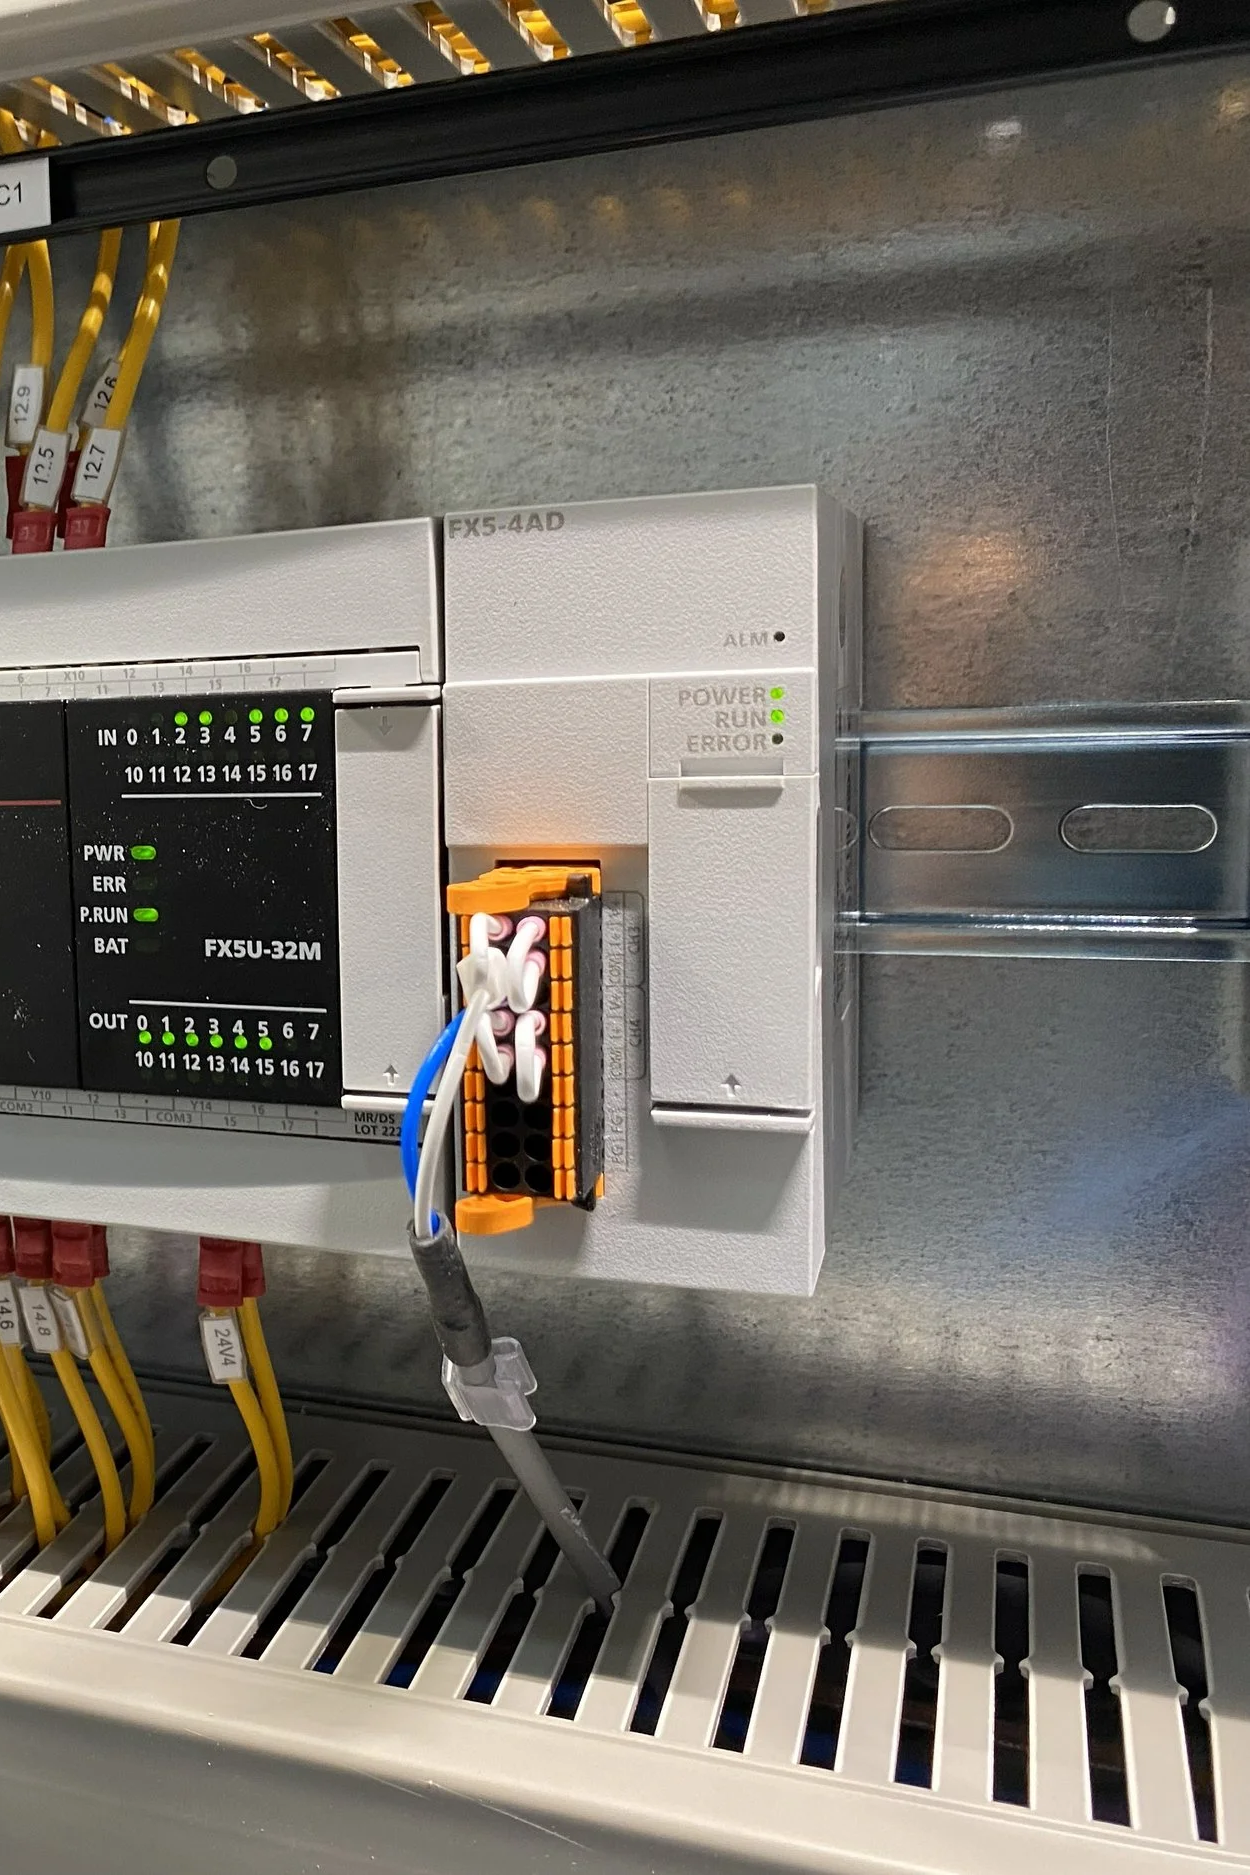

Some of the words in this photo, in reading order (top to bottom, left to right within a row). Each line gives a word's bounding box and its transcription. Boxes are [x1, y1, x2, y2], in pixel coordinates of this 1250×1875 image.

[13, 386, 31, 424] 12.9
[83, 444, 105, 482] 12.7
[448, 511, 565, 538] FX5-4AD
[724, 632, 769, 648] ALM
[17, 673, 24, 683] 6
[63, 671, 85, 681] X10
[123, 668, 136, 679] 12
[180, 665, 193, 676] 14
[238, 663, 251, 673] 16
[45, 686, 50, 697] 7
[96, 684, 108, 695] 11
[151, 681, 165, 693] 13
[209, 679, 222, 690] 15
[268, 676, 281, 688] 17
[678, 686, 766, 706] POWER
[716, 709, 767, 729] RUN
[98, 729, 117, 746] IN
[126, 728, 137, 745] 0
[151, 728, 160, 745] 1
[175, 727, 186, 744] 2
[199, 727, 210, 744] 3
[224, 727, 236, 744] 4
[250, 726, 261, 743] 5
[275, 725, 286, 742] 6
[301, 725, 312, 742] 7
[686, 733, 768, 753] ERROR
[125, 767, 143, 784] 10
[149, 767, 166, 783] 11
[173, 766, 191, 783] 12
[198, 766, 216, 782] 13
[222, 765, 241, 782] 14
[247, 765, 266, 782] 15
[273, 764, 292, 781] 16
[299, 764, 317, 781] 17
[83, 845, 125, 862] PWR
[92, 876, 126, 892] ERR
[79, 906, 128, 924] P.RUN
[94, 937, 128, 954] BAT
[204, 938, 322, 961] FX5U-32M
[89, 1013, 128, 1030] OUT
[136, 1015, 148, 1031] 0
[162, 1016, 170, 1032] 1
[184, 1017, 195, 1033] 2
[208, 1018, 219, 1034] 3
[232, 1019, 244, 1036] 4
[258, 1021, 268, 1038] 5
[282, 1022, 294, 1039] 6
[308, 1023, 320, 1040] 7
[135, 1051, 153, 1068] 10
[159, 1052, 176, 1069] 11
[182, 1053, 201, 1070] 12
[206, 1055, 225, 1072] 13
[230, 1056, 249, 1074] 14
[255, 1057, 274, 1076] 15
[280, 1059, 299, 1077] 16
[305, 1061, 324, 1078] 17
[31, 1089, 51, 1101] Y10
[88, 1093, 99, 1104] 12
[190, 1099, 212, 1112] Y14
[252, 1104, 265, 1115] 16
[0, 1101, 34, 1113] COM2
[62, 1105, 73, 1116] 11
[114, 1108, 127, 1120] 13
[156, 1112, 192, 1124] COM3
[224, 1115, 237, 1127] 15
[281, 1119, 294, 1131] 17
[354, 1111, 395, 1125] MR/DS
[354, 1124, 379, 1136] LOT
[32, 1304, 51, 1337] 14.8
[214, 1328, 237, 1367] 24V4
